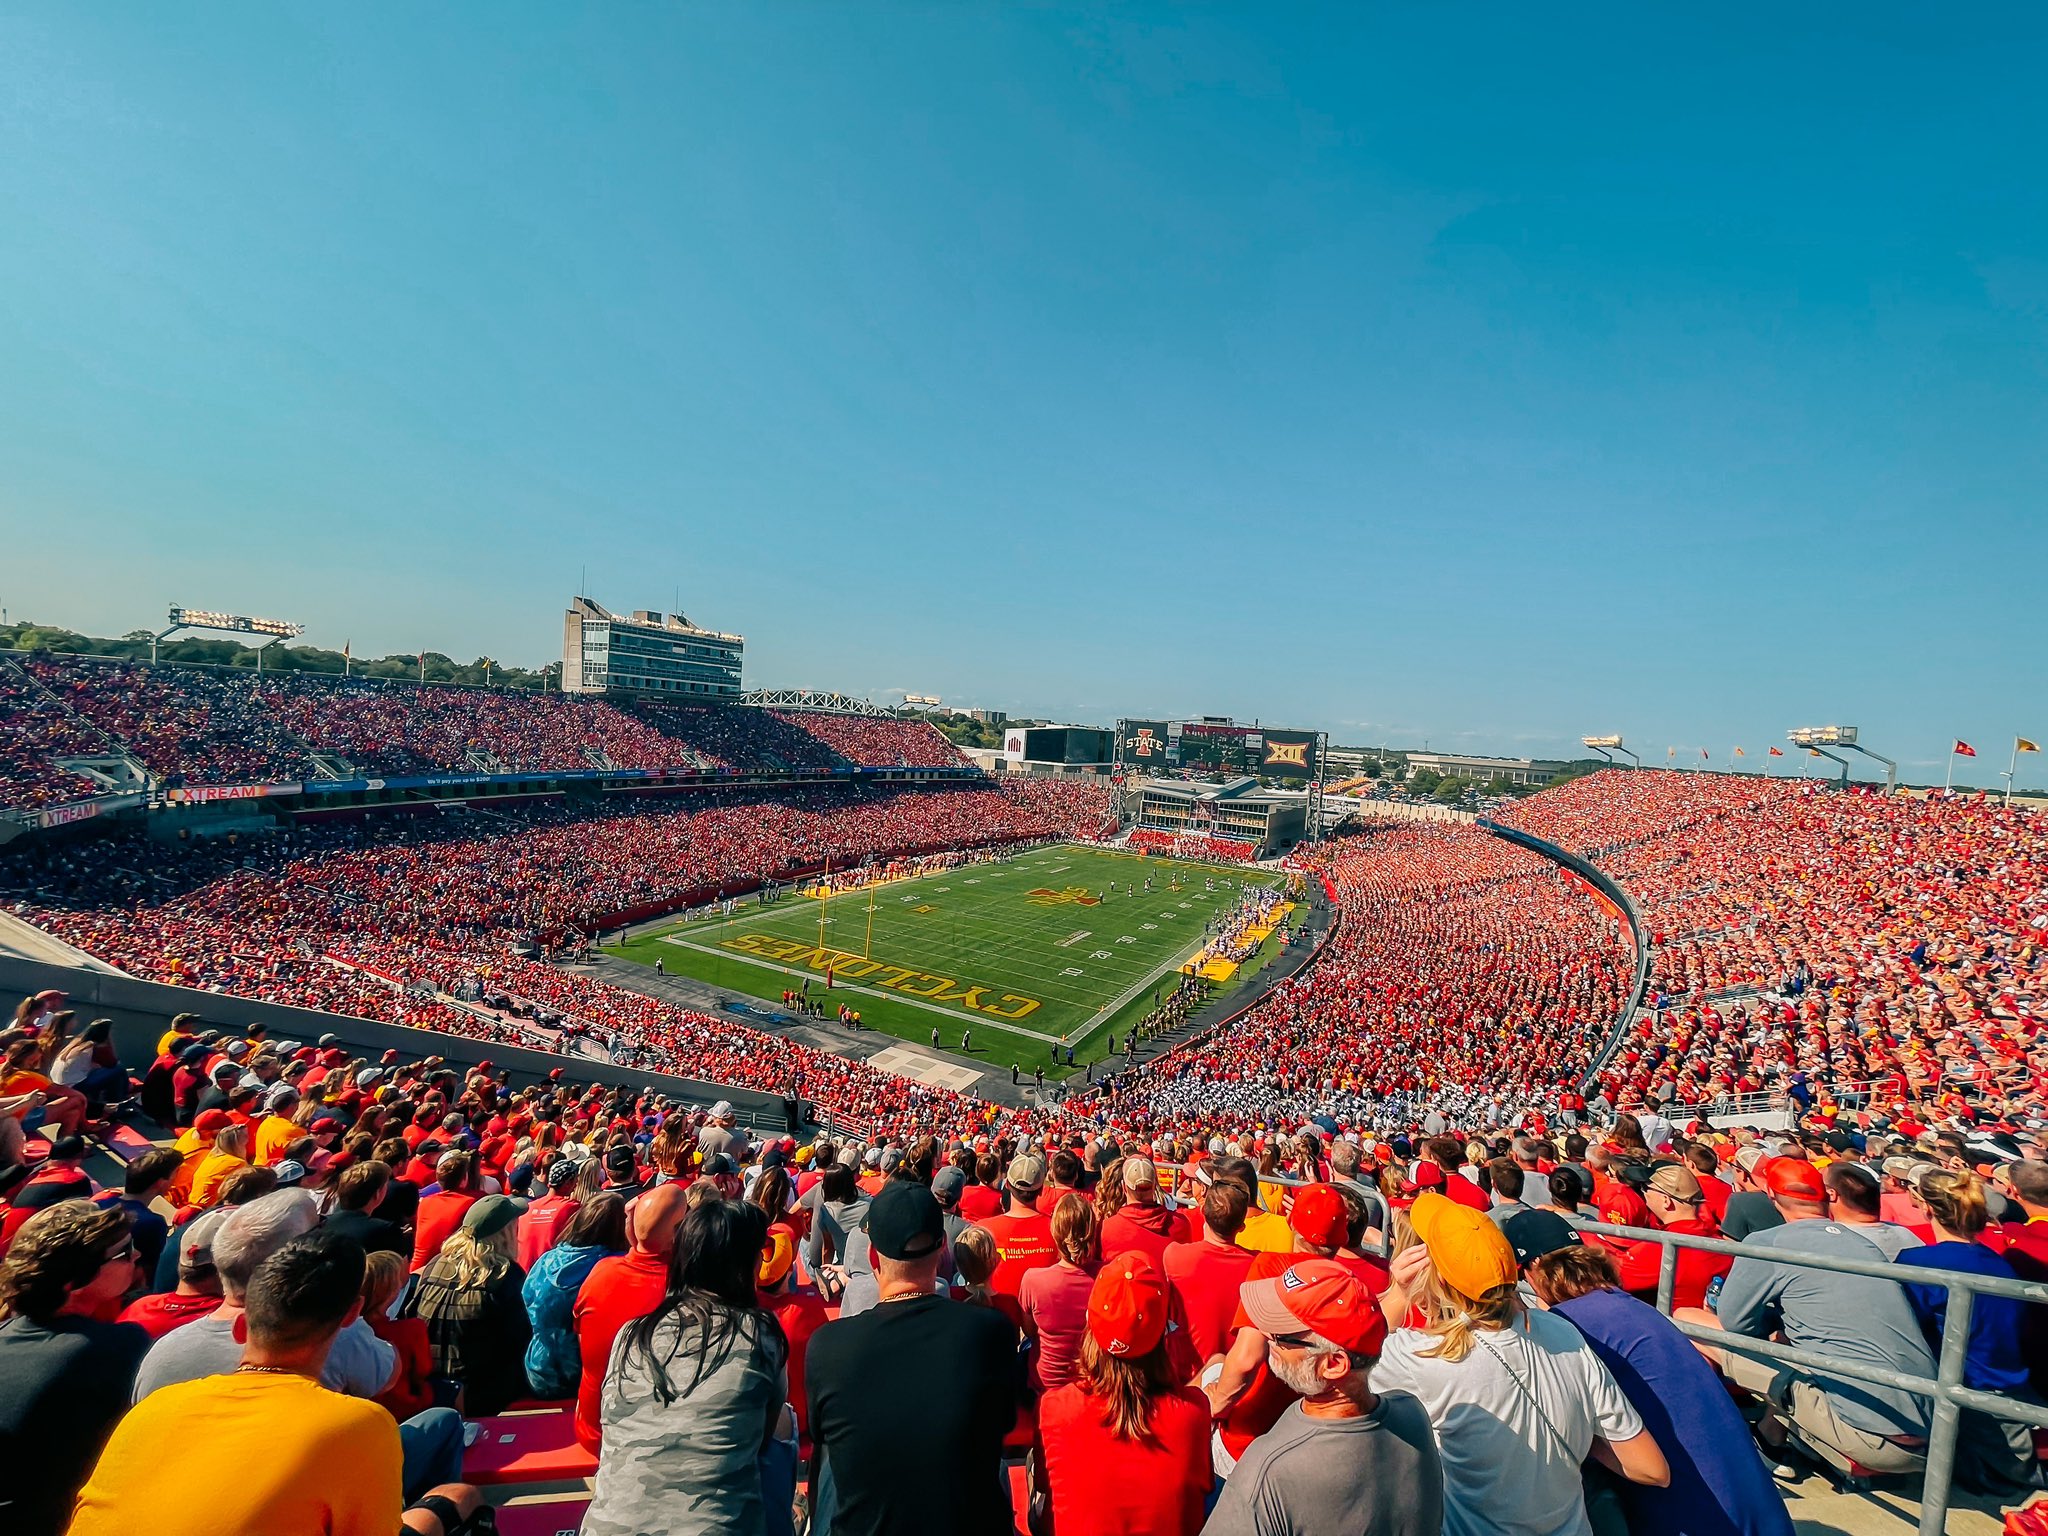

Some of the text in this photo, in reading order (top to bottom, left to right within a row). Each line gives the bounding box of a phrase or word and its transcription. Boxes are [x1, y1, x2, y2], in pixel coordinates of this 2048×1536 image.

[1126, 737, 1164, 752] STATE
[1265, 741, 1309, 767] XII
[183, 785, 256, 801] XTREAM
[47, 803, 95, 825] XTREAM
[720, 934, 1041, 1019] CYCLONES
[1062, 967, 1083, 977] 10
[1006, 1246, 1054, 1255] MidAmerican
